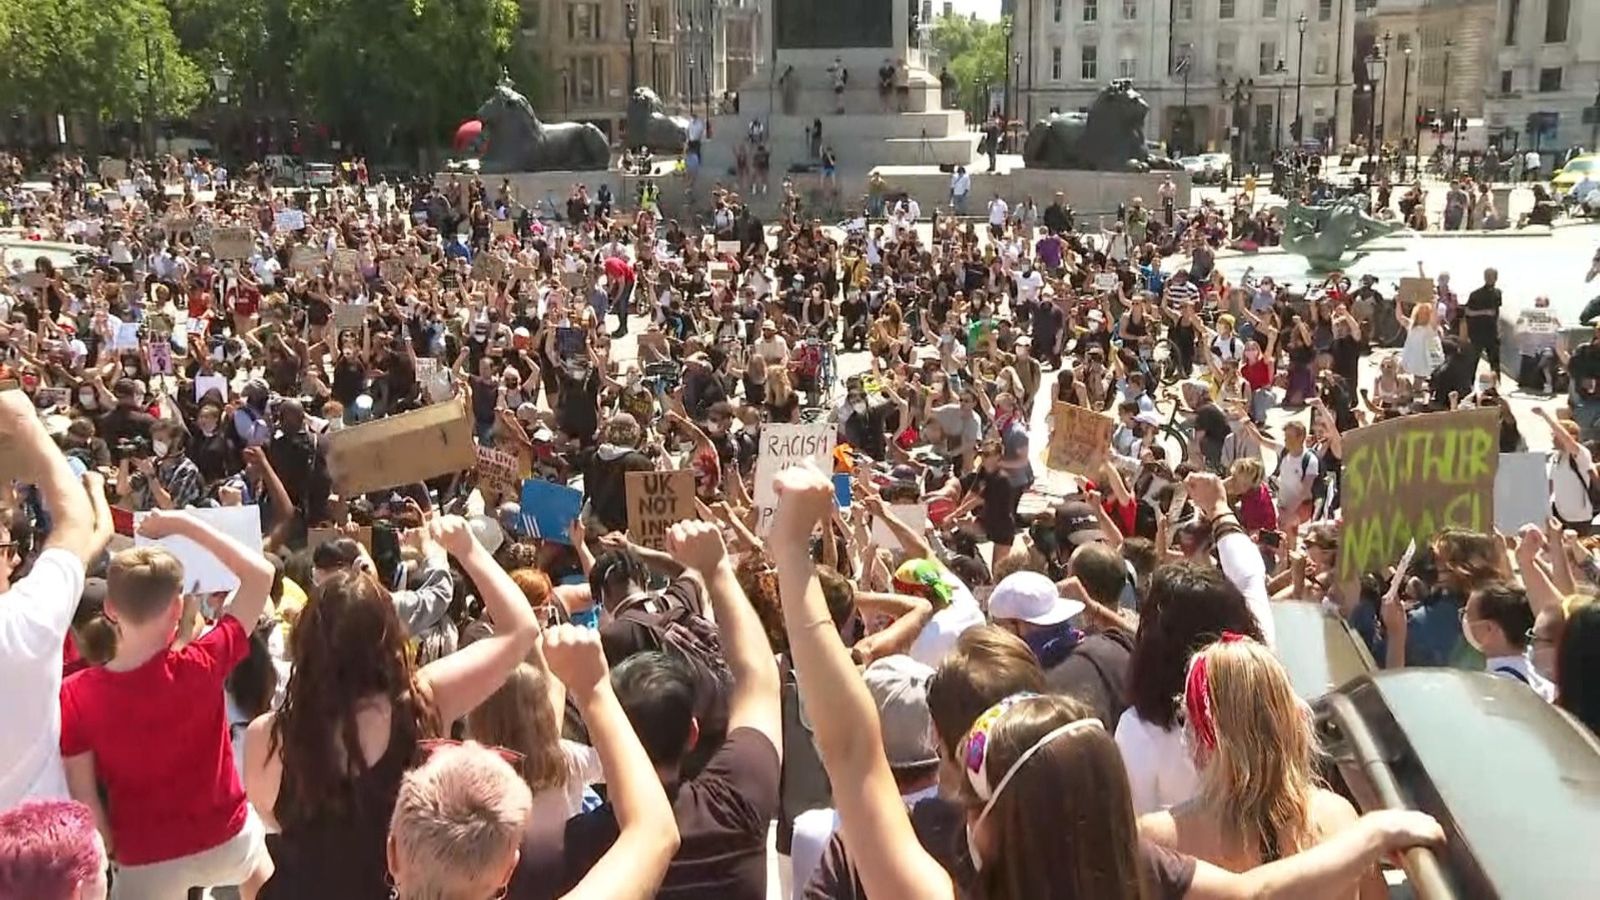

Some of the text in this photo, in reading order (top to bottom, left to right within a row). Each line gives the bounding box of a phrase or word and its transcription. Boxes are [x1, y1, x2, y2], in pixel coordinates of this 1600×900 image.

[767, 434, 828, 457] RACISM
[1346, 432, 1403, 508] SAY
[643, 473, 676, 495] UK
[638, 496, 679, 515] NOT
